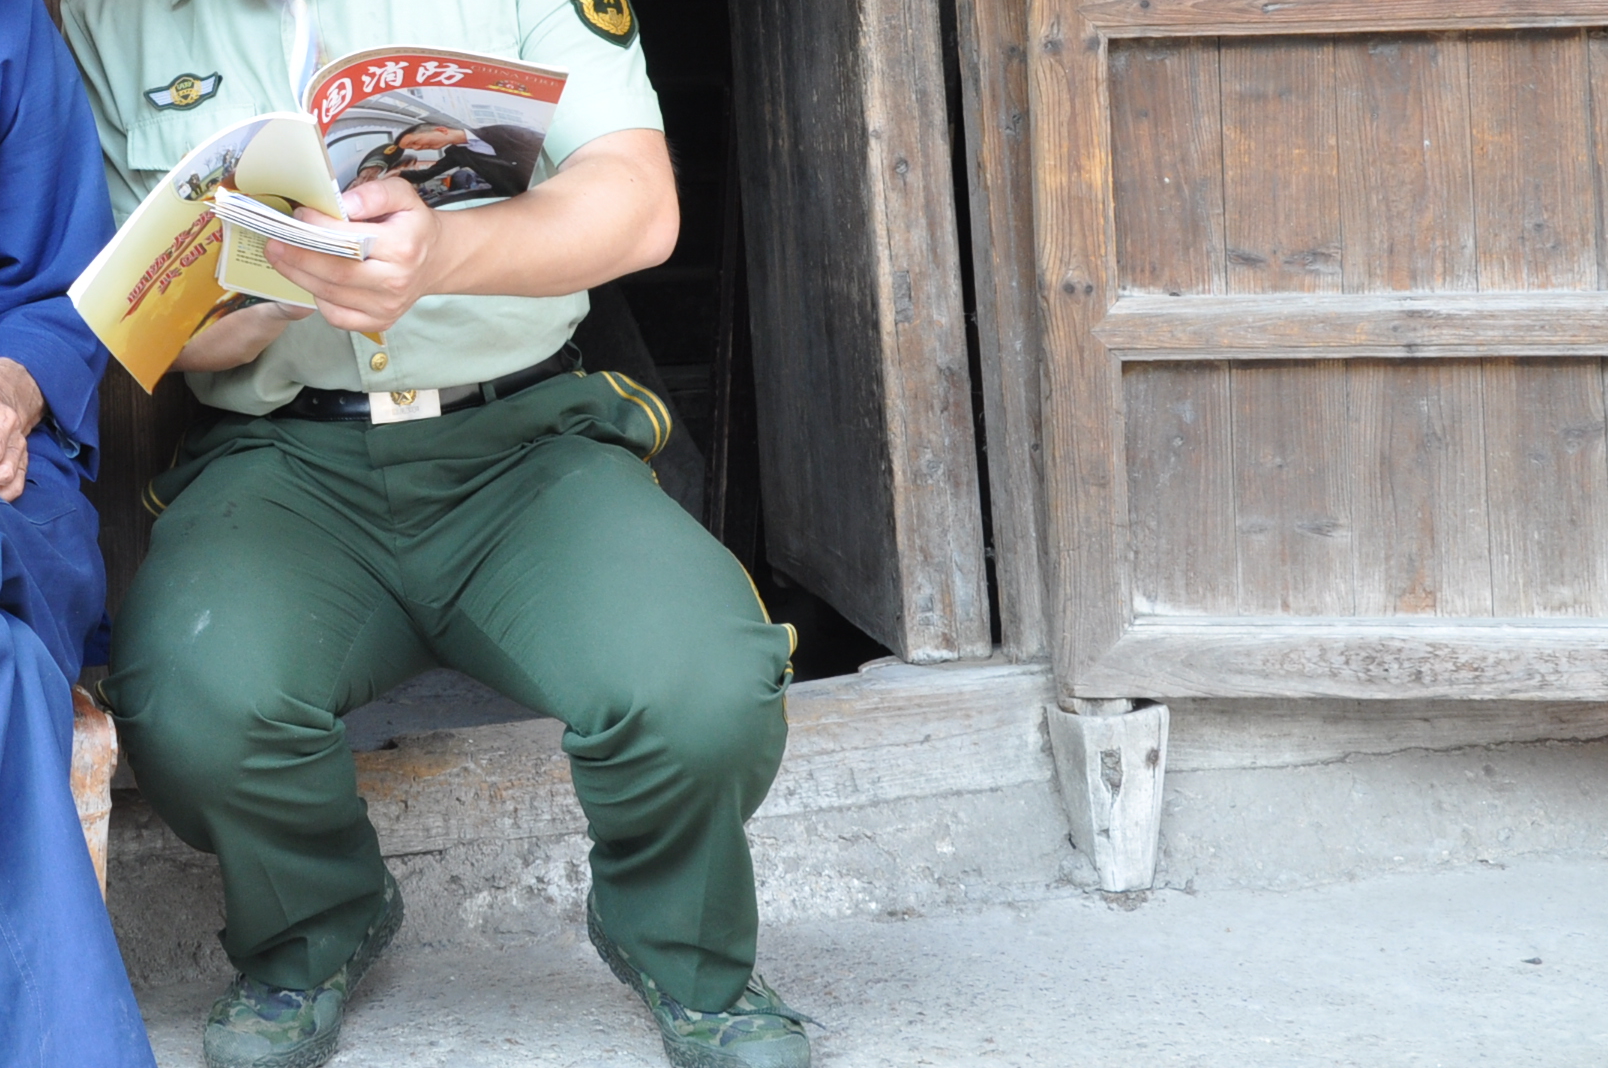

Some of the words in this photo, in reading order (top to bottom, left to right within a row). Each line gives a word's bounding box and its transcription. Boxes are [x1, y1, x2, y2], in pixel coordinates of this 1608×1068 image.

[471, 65, 519, 79] CHINA
[312, 60, 473, 124] 国消防
